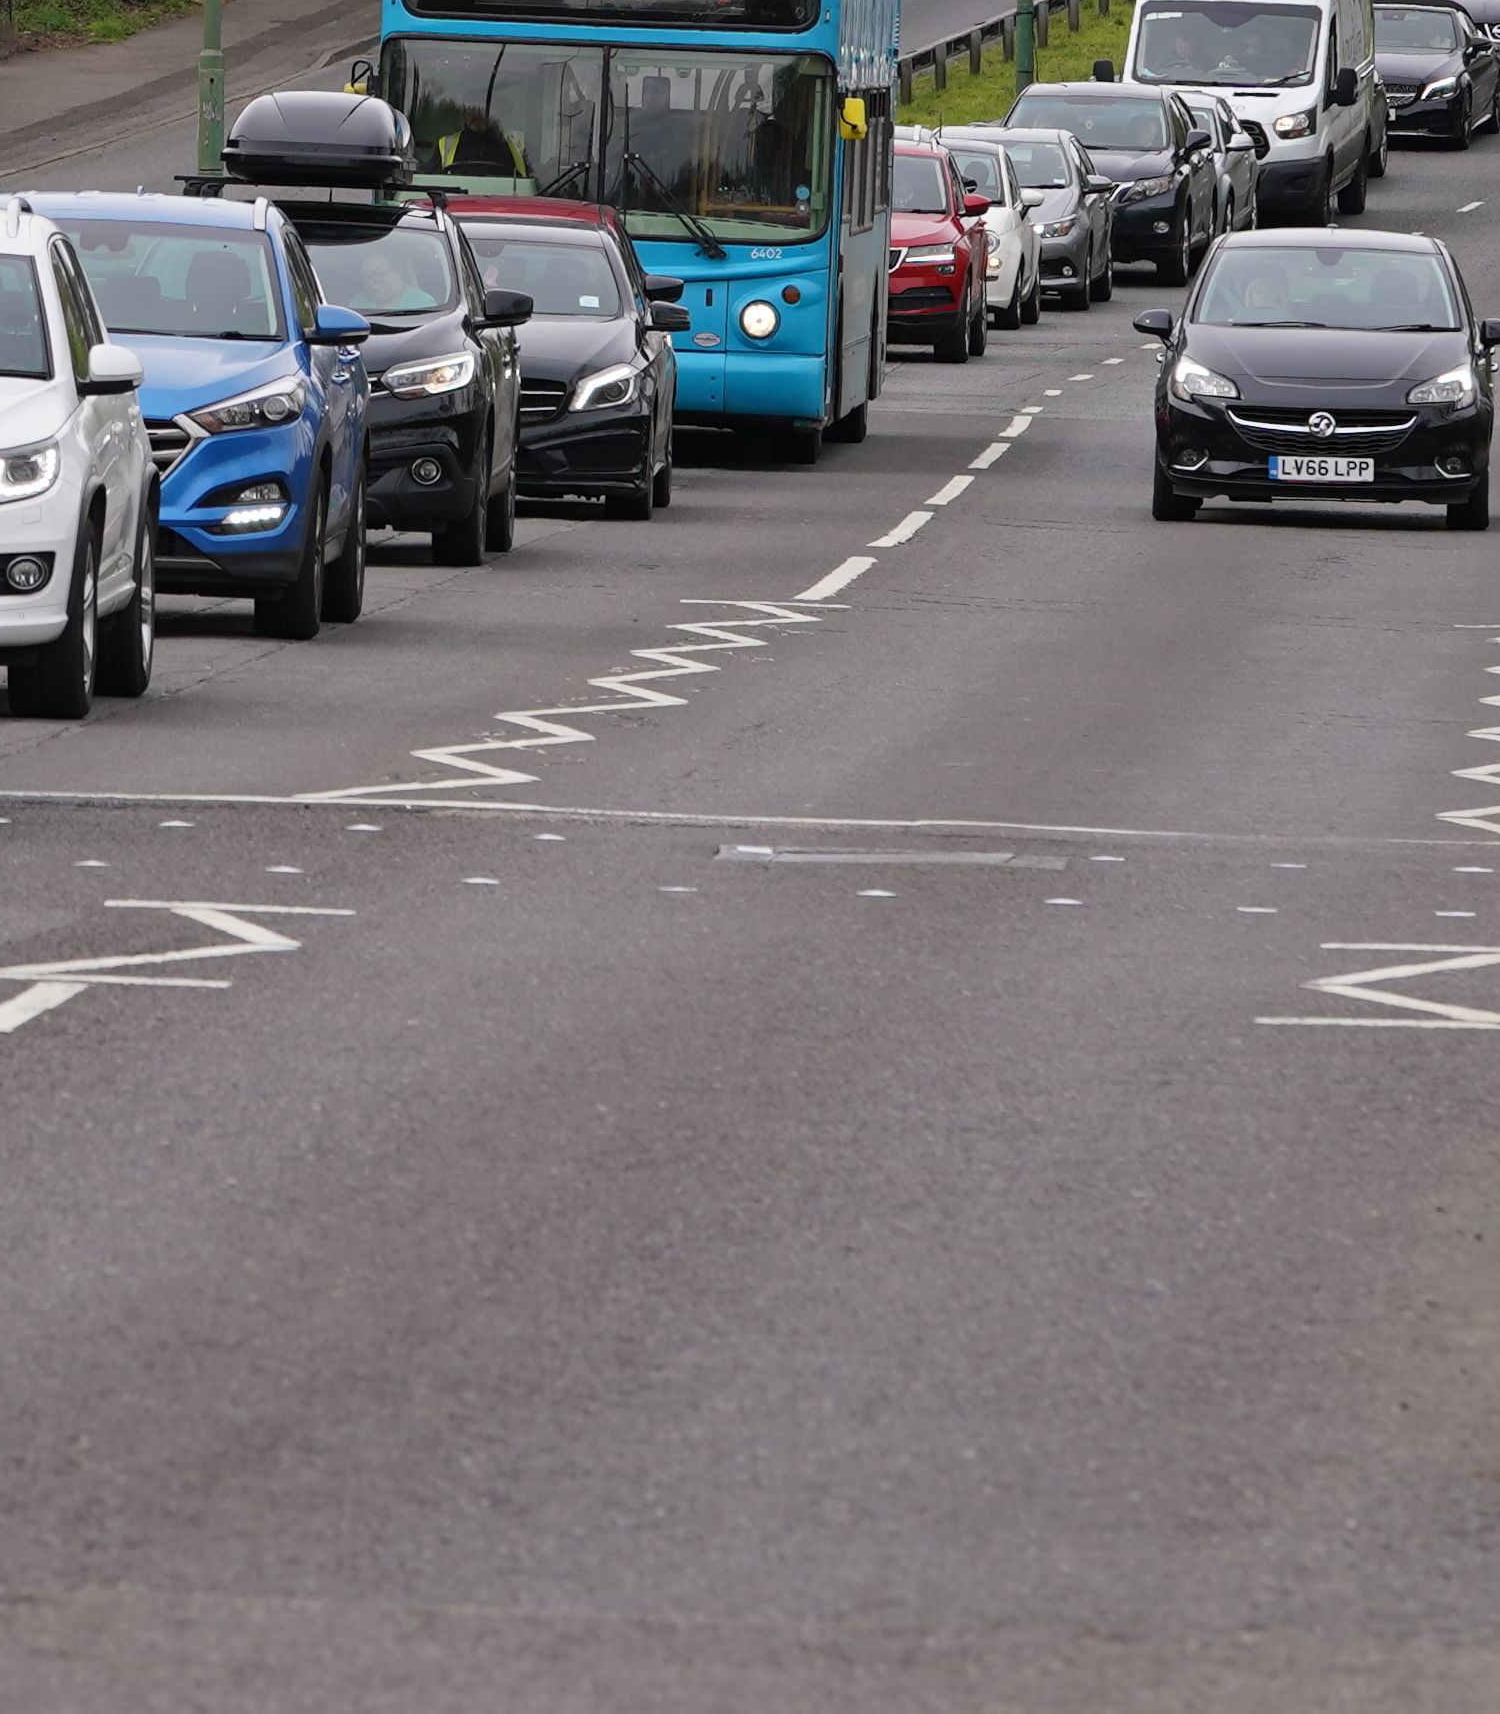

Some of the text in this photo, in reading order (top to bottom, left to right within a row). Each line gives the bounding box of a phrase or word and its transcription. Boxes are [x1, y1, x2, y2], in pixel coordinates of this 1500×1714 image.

[750, 248, 782, 260] 6402
[1281, 459, 1370, 477] LV66 LPP
